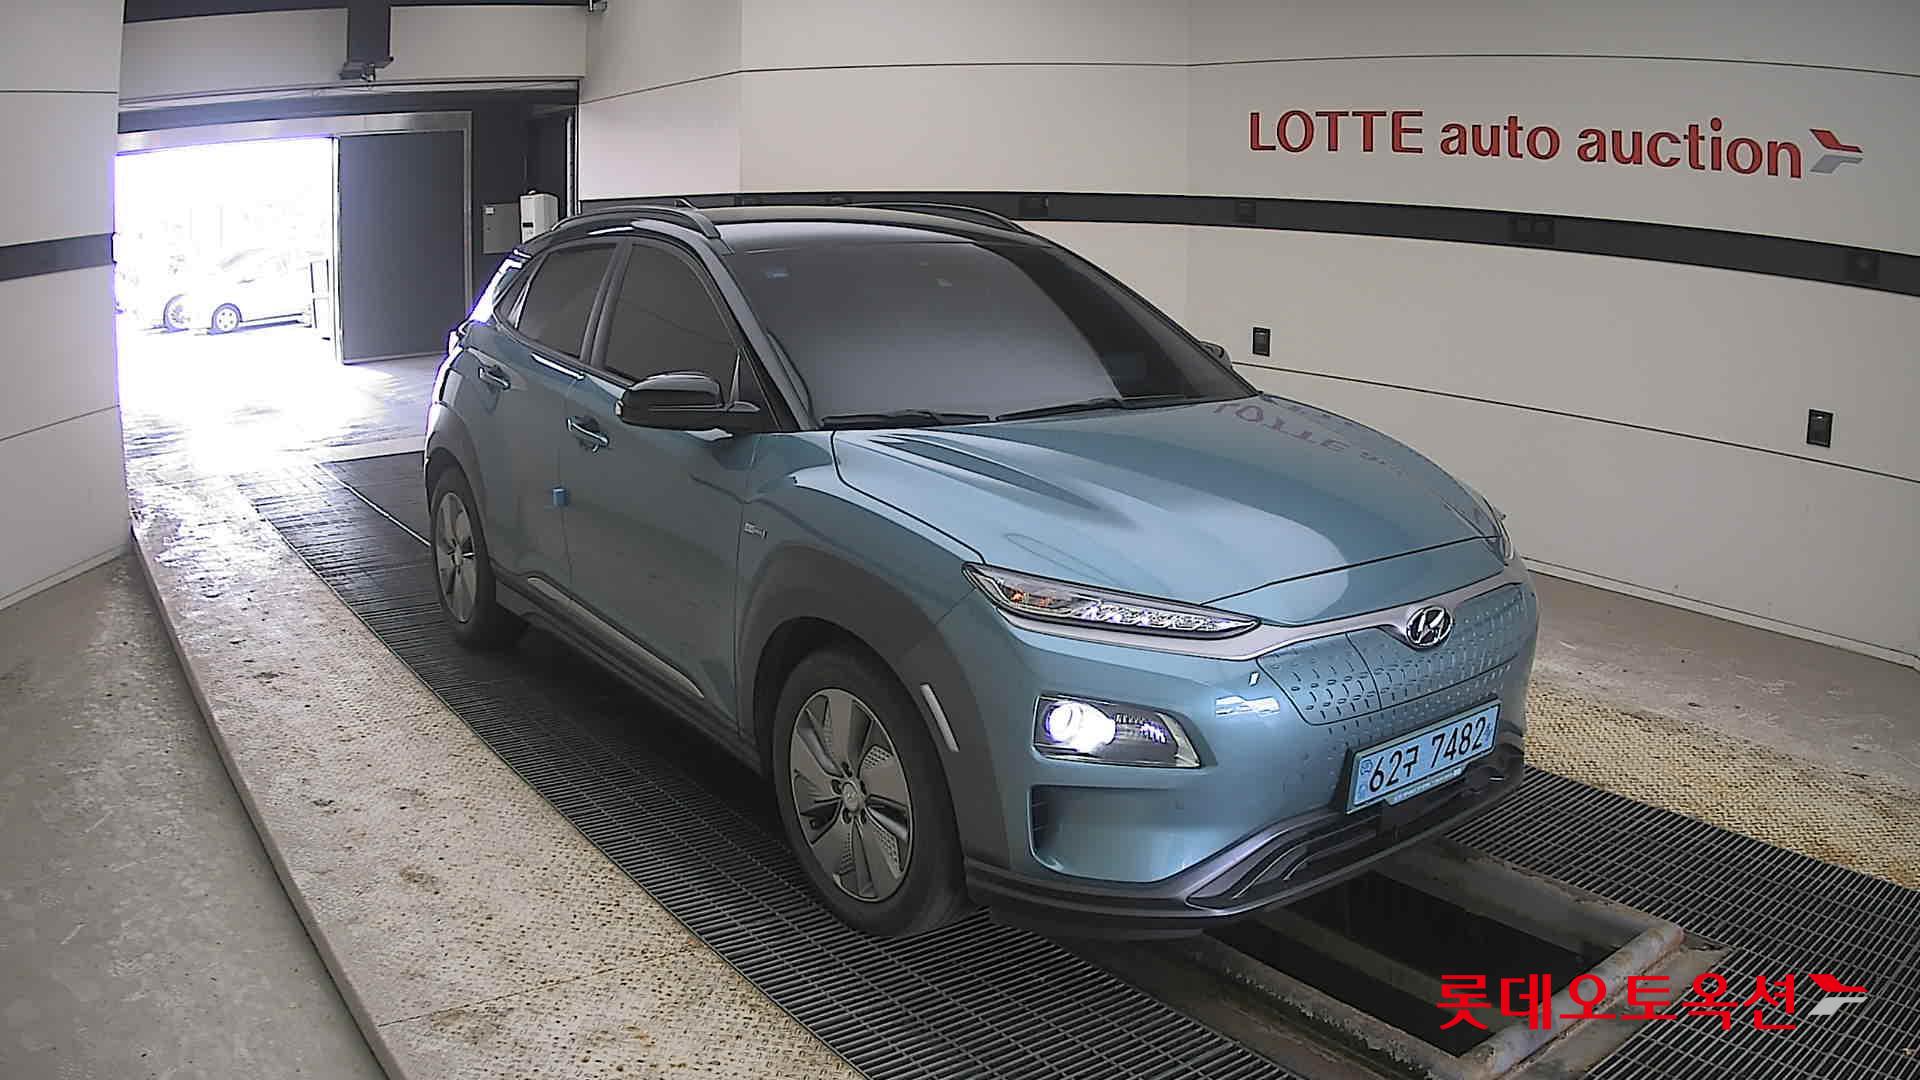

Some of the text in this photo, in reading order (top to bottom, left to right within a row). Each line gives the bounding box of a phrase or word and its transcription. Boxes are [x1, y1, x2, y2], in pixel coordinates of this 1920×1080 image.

[1249, 110, 1803, 179] LOTTE auto auction
[1370, 745, 1419, 792] 62구
[1431, 717, 1486, 768] 7482
